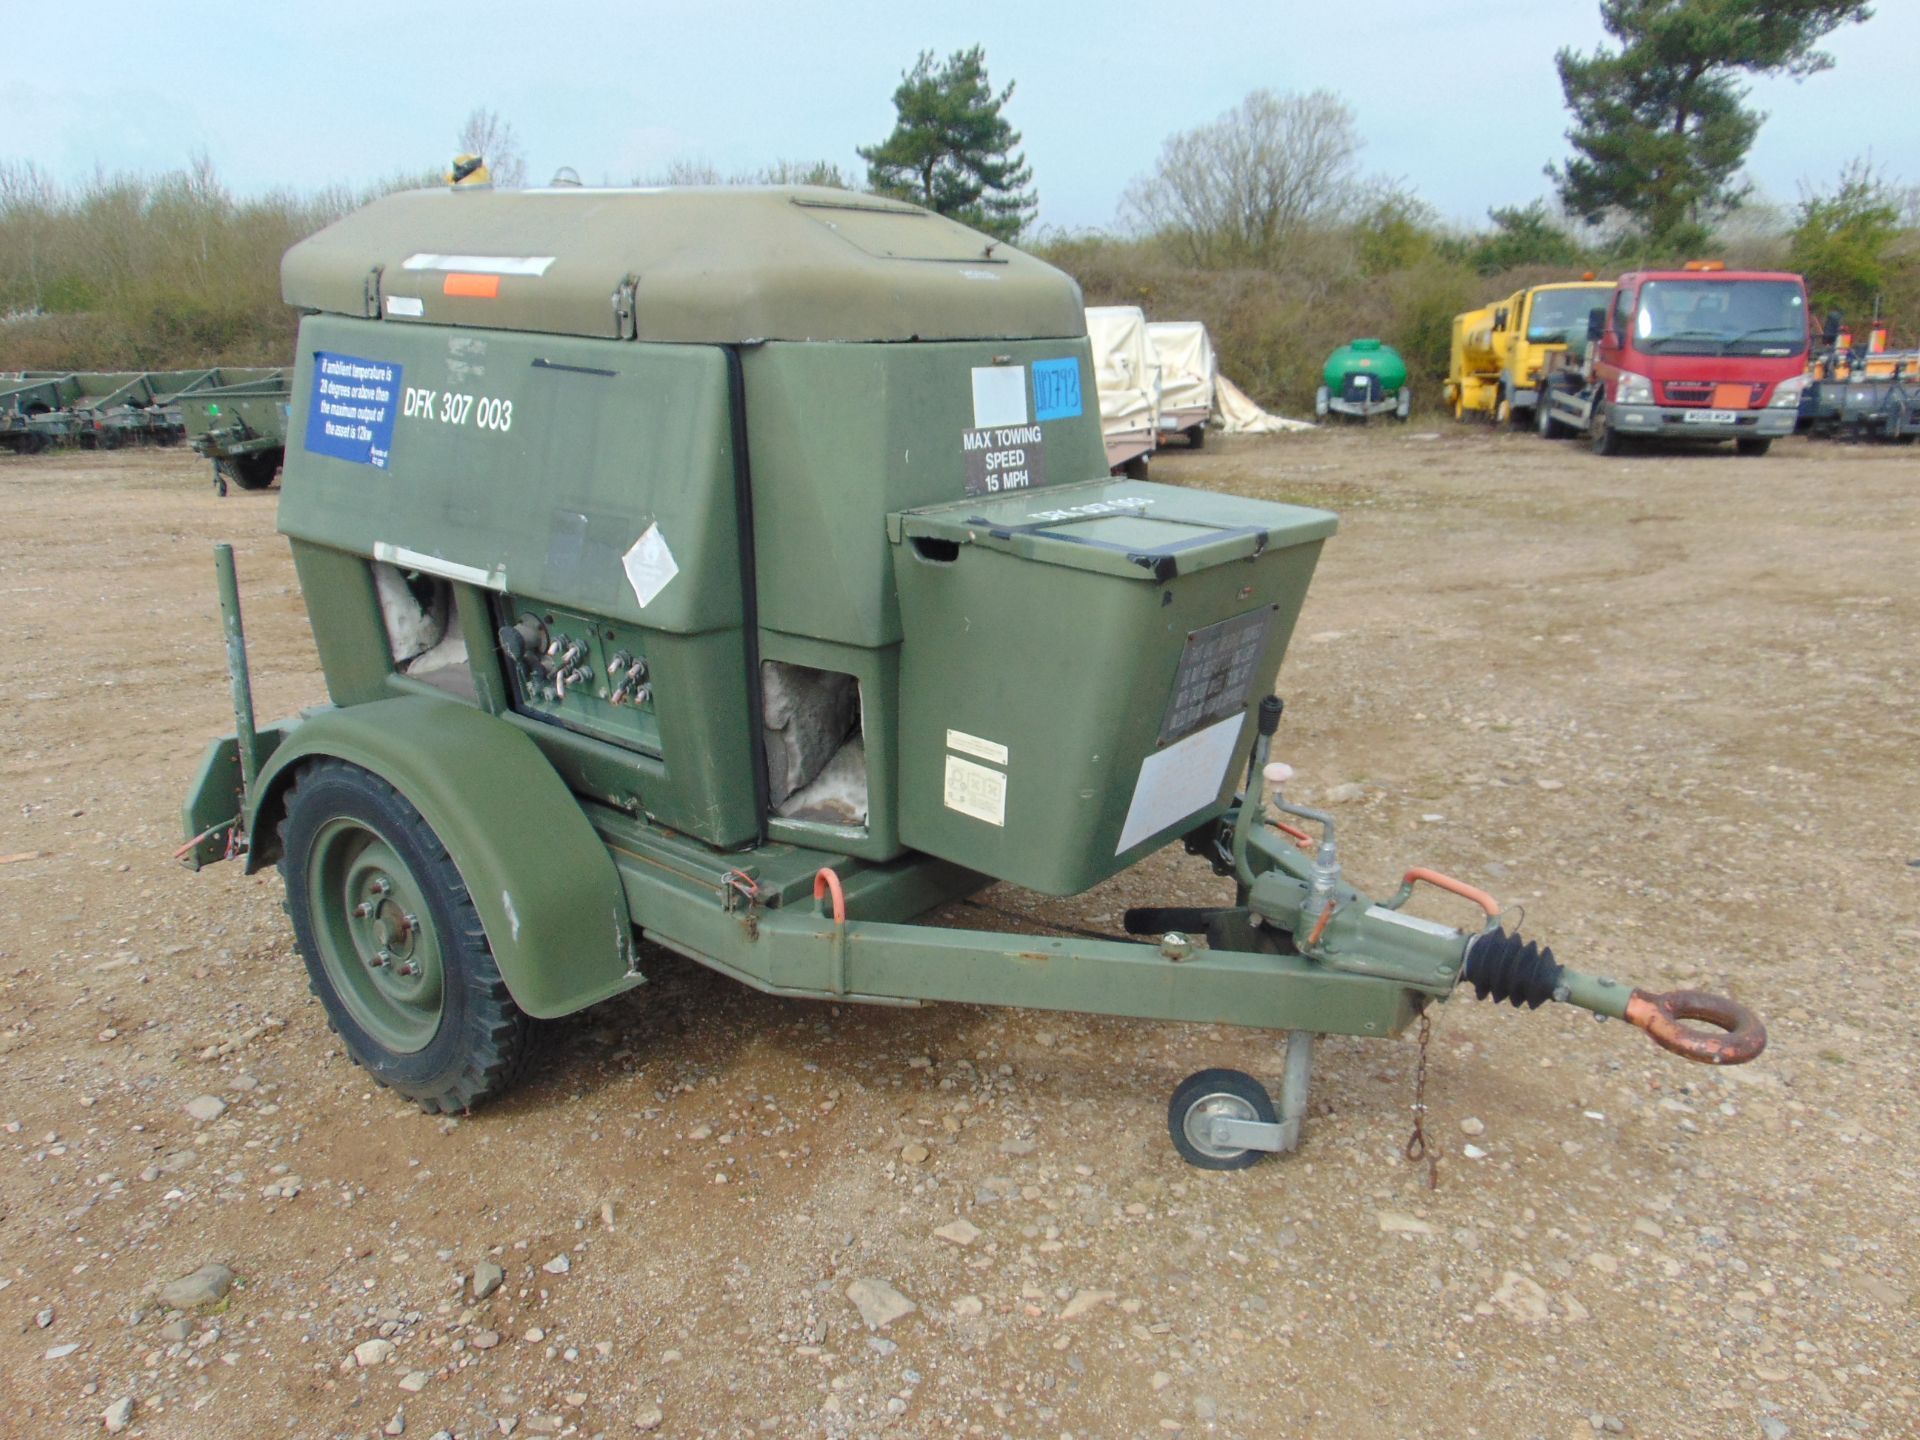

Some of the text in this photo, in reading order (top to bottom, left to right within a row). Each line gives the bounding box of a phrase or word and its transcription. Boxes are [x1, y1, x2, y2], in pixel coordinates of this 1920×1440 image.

[403, 387, 513, 432] DFK 307 003
[963, 426, 1042, 450] MAX TOWING
[985, 449, 1025, 470] SPEED
[985, 470, 1029, 492] 15 MPH
